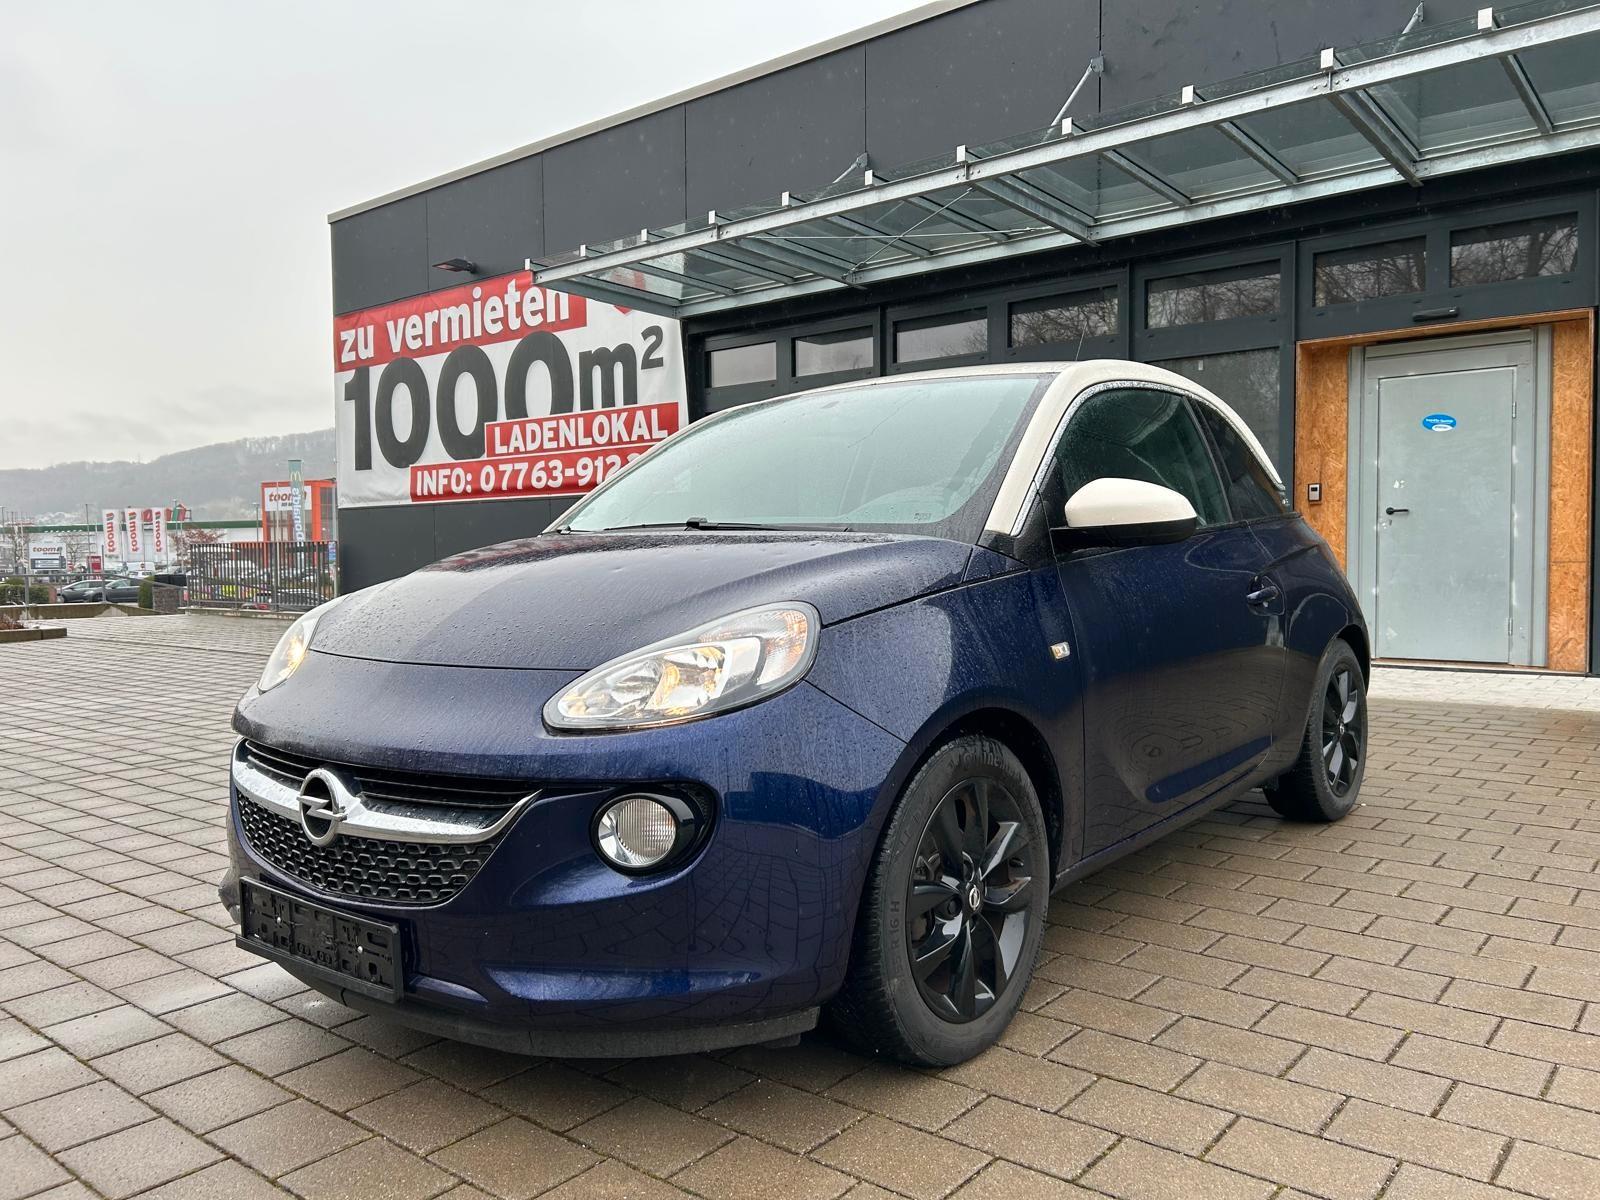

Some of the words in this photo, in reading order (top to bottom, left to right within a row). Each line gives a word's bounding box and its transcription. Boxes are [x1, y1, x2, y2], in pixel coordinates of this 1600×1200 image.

[340, 324, 375, 364] zu
[386, 278, 570, 353] vermieten
[493, 407, 669, 455] LADENLOKAL
[415, 467, 472, 497] INFO:
